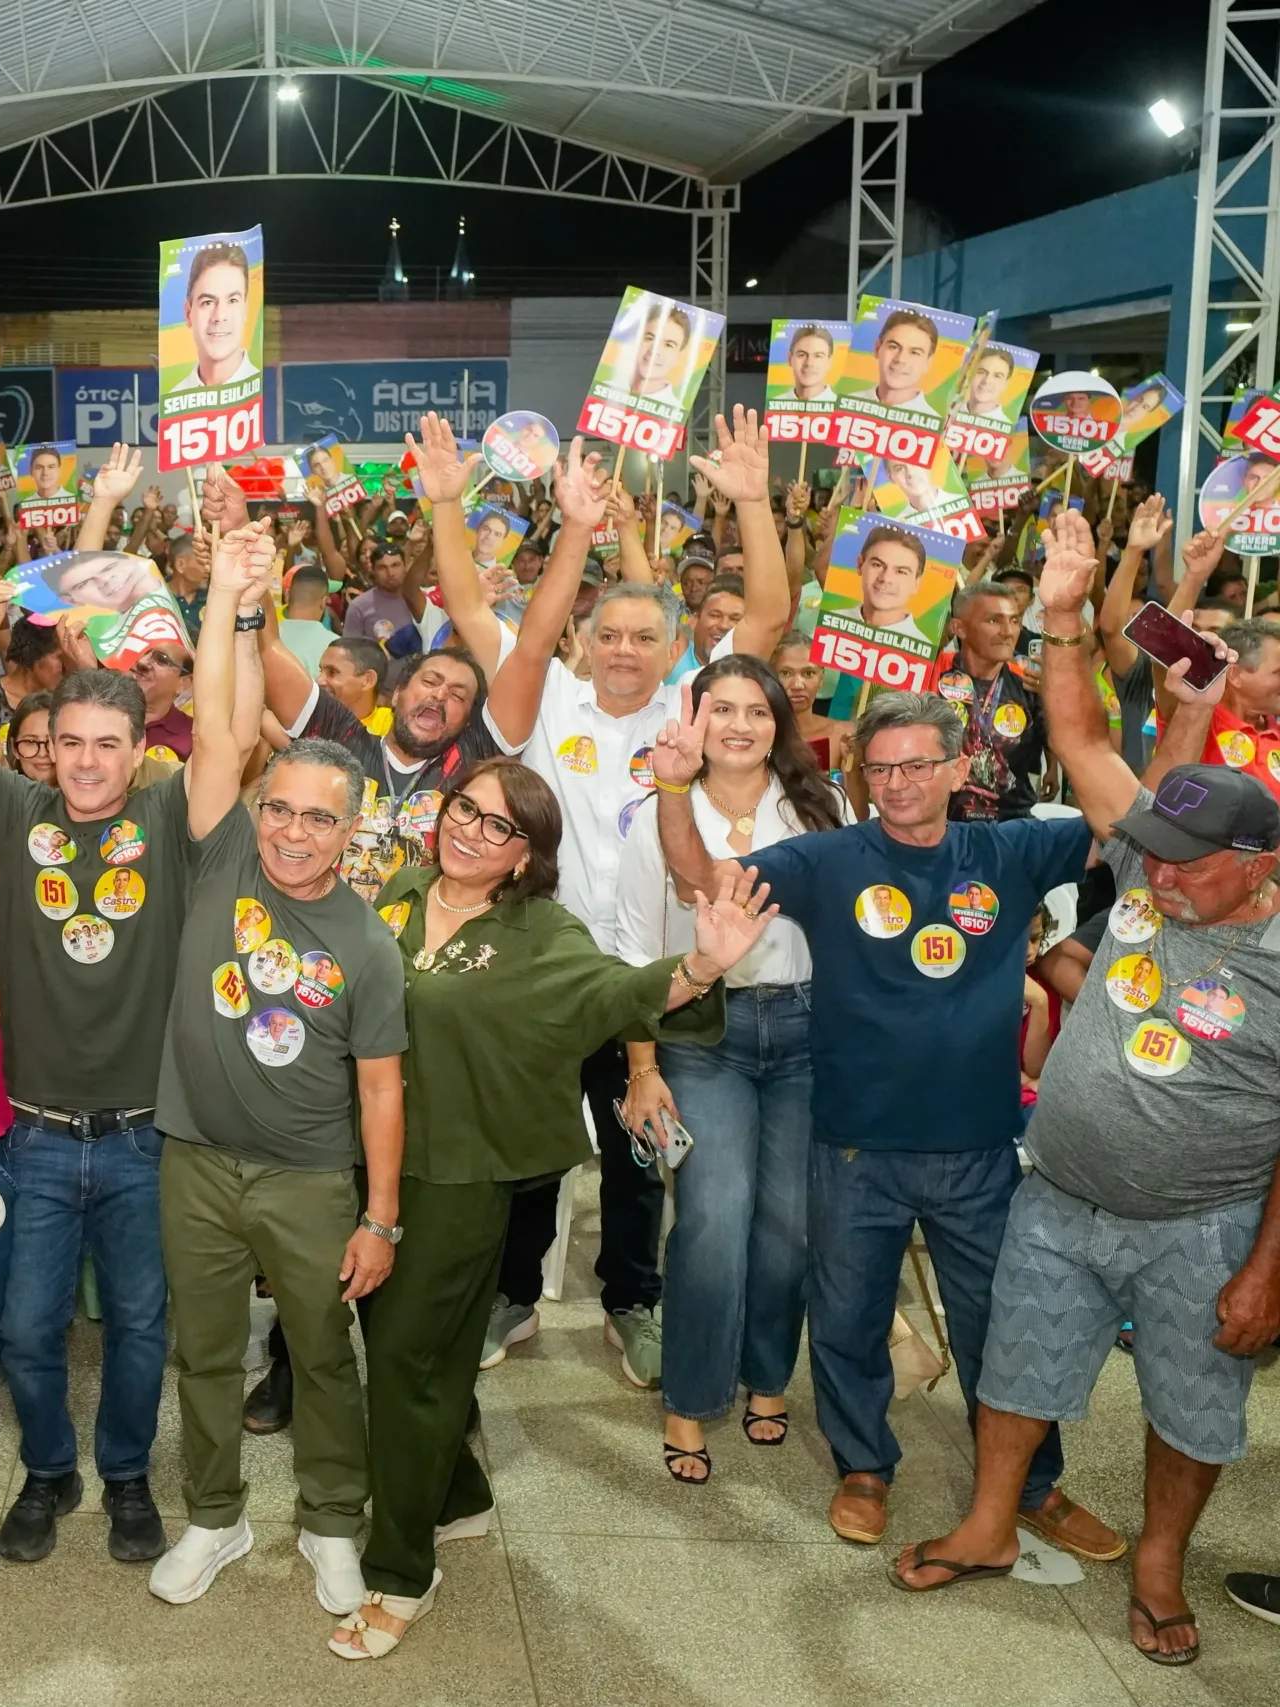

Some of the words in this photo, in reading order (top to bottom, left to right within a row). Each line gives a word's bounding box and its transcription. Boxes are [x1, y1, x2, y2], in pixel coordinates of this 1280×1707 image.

[75, 386, 135, 401] ÓTICA
[164, 390, 218, 414] SEVERO
[768, 401, 804, 411] SEVERO
[840, 397, 887, 419] SEVERO
[164, 402, 261, 465] 15101
[586, 402, 678, 458] 15101
[767, 416, 830, 439] 1510
[1043, 415, 1109, 441] 15101
[835, 415, 935, 466] 15101
[1057, 436, 1089, 448] SEVERO
[490, 434, 537, 477] 15101
[971, 480, 997, 490] SEVERO
[22, 506, 79, 528] 15101
[591, 529, 619, 545] 1510
[1234, 534, 1277, 546] SEVERO
[822, 614, 874, 641] SEVERO
[818, 633, 927, 694] 15101
[562, 755, 592, 769] Castro
[637, 776, 654, 785] 151
[47, 848, 63, 862] 13
[112, 846, 141, 864] 15101
[41, 878, 67, 905] 151
[102, 896, 137, 906] Castro
[958, 915, 988, 931] 15101
[234, 927, 250, 947] stro
[922, 936, 953, 960] 151
[296, 983, 327, 1007] 15101
[1114, 980, 1151, 1003] Castro
[1180, 1002, 1207, 1021] SEVERO
[1181, 1011, 1223, 1038] 15101
[1140, 1029, 1179, 1061] 151
